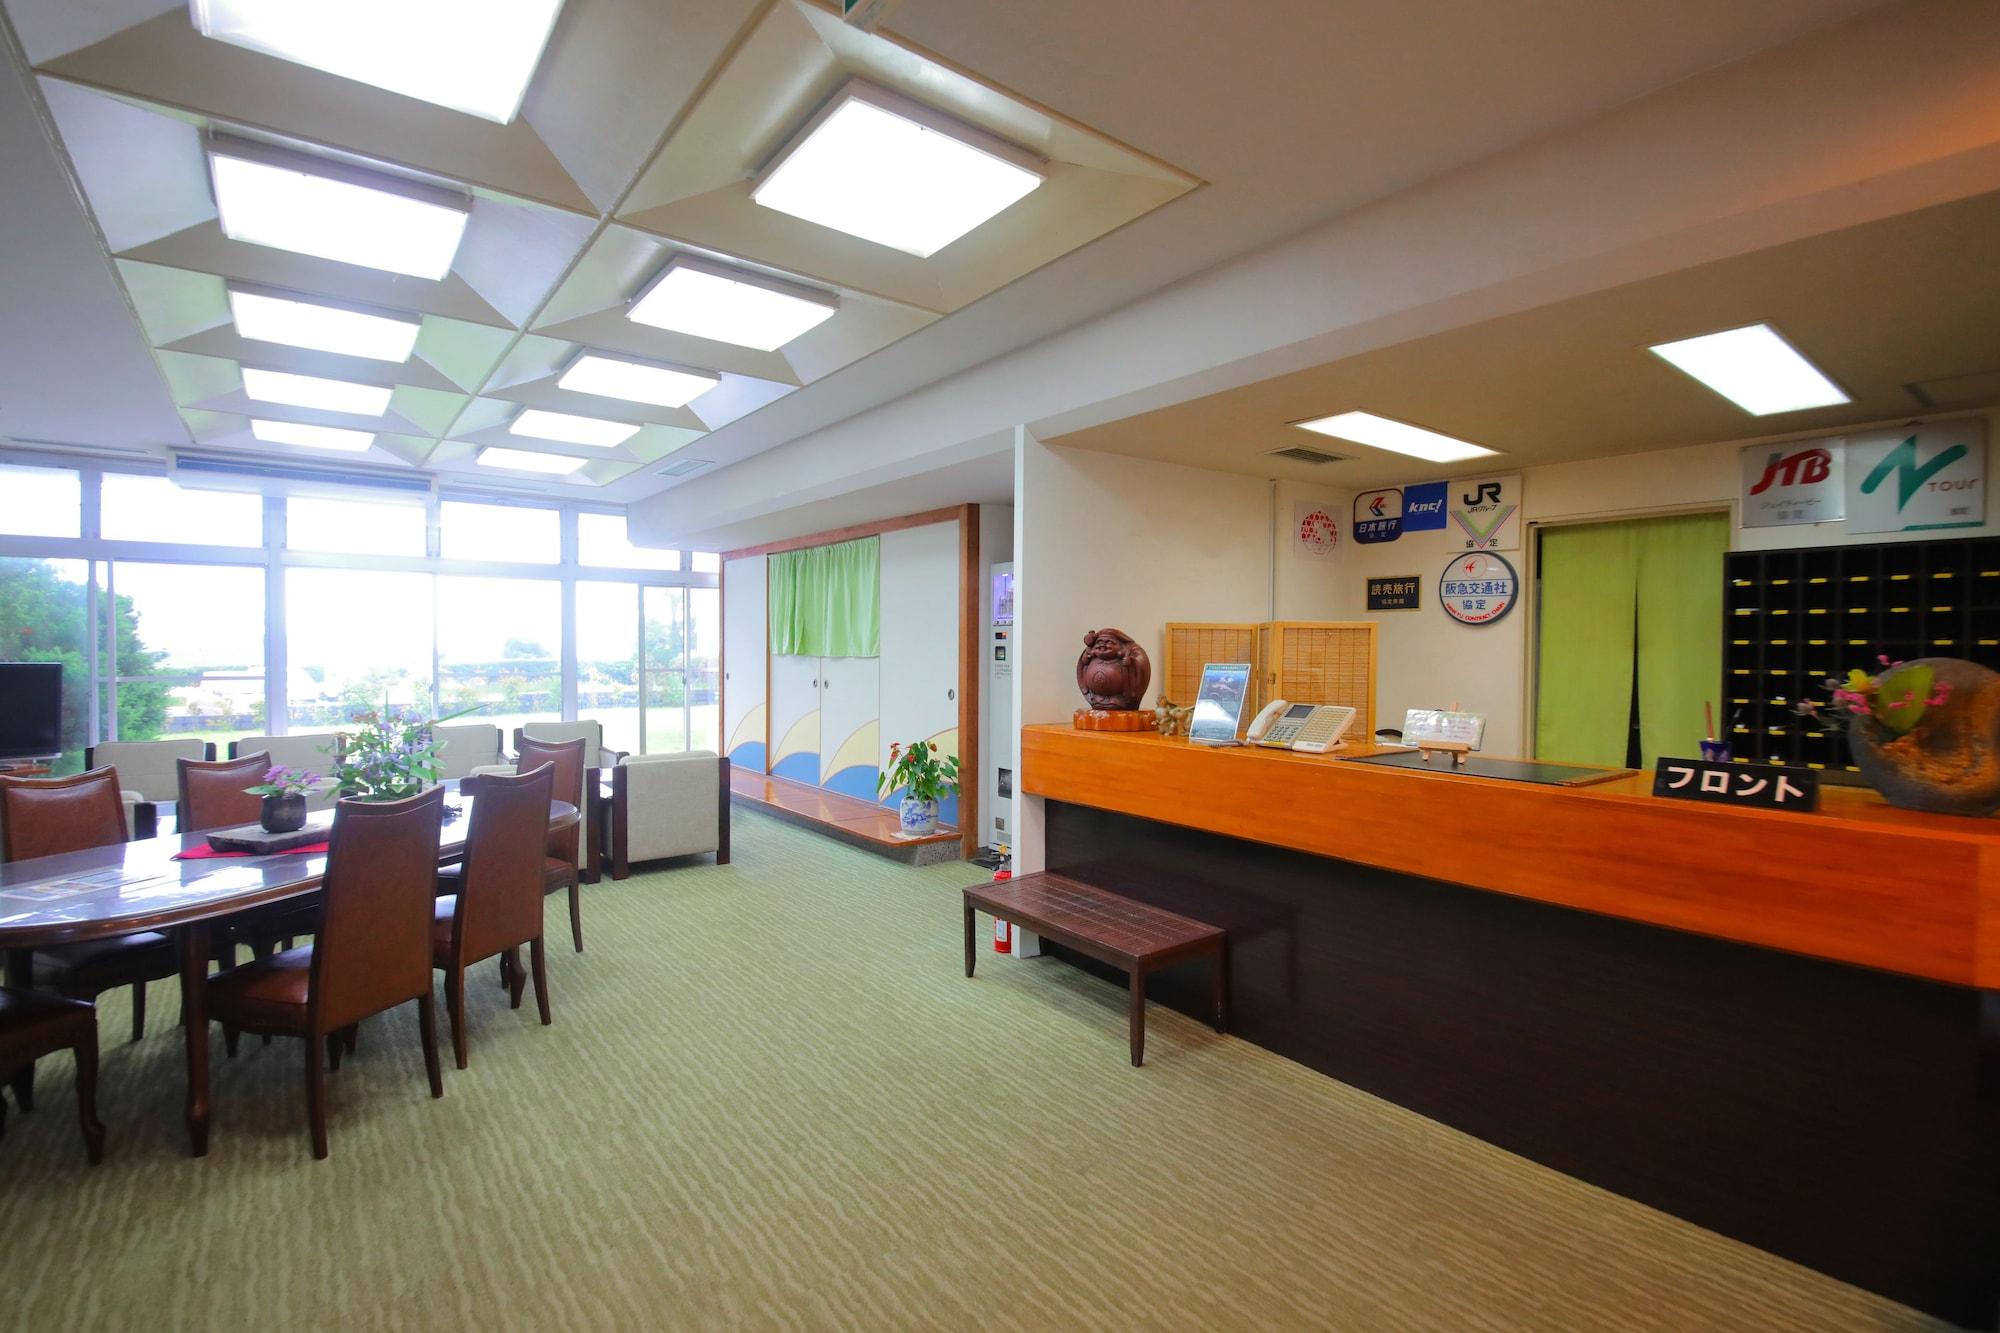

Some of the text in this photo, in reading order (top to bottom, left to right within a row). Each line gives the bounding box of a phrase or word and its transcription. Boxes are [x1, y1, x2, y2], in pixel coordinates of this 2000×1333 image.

[1749, 448, 1832, 496] JTB
[1463, 482, 1502, 506] JR
[1359, 520, 1397, 533] 日本旅行
[1371, 582, 1416, 596] 読売旅行
[1445, 581, 1508, 595] 阪急交通社
[1462, 599, 1486, 610] 協定
[1666, 766, 1804, 803] フロント
